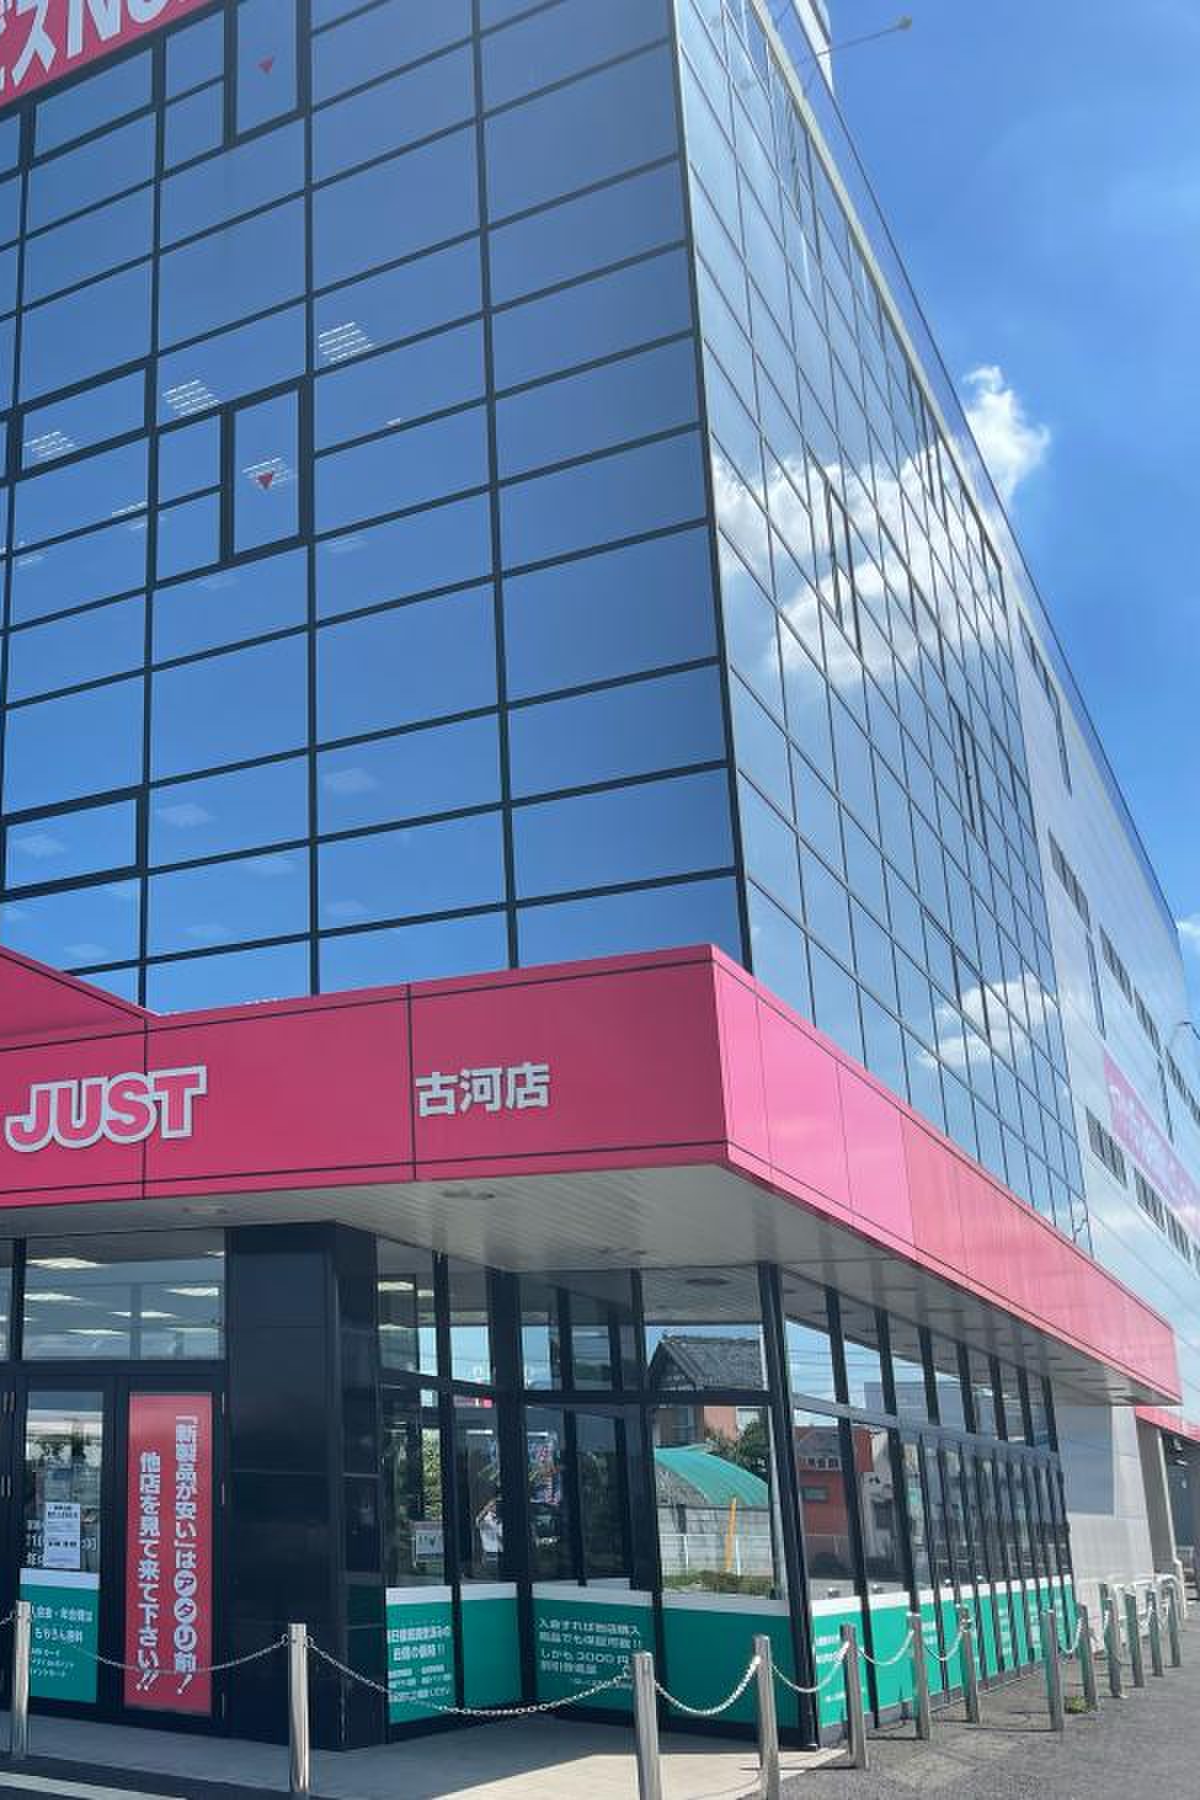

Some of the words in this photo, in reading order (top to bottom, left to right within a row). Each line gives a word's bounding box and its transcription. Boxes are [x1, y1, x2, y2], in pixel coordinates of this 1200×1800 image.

[5, 1066, 207, 1153] JUST
[415, 1062, 550, 1117] 古河店
